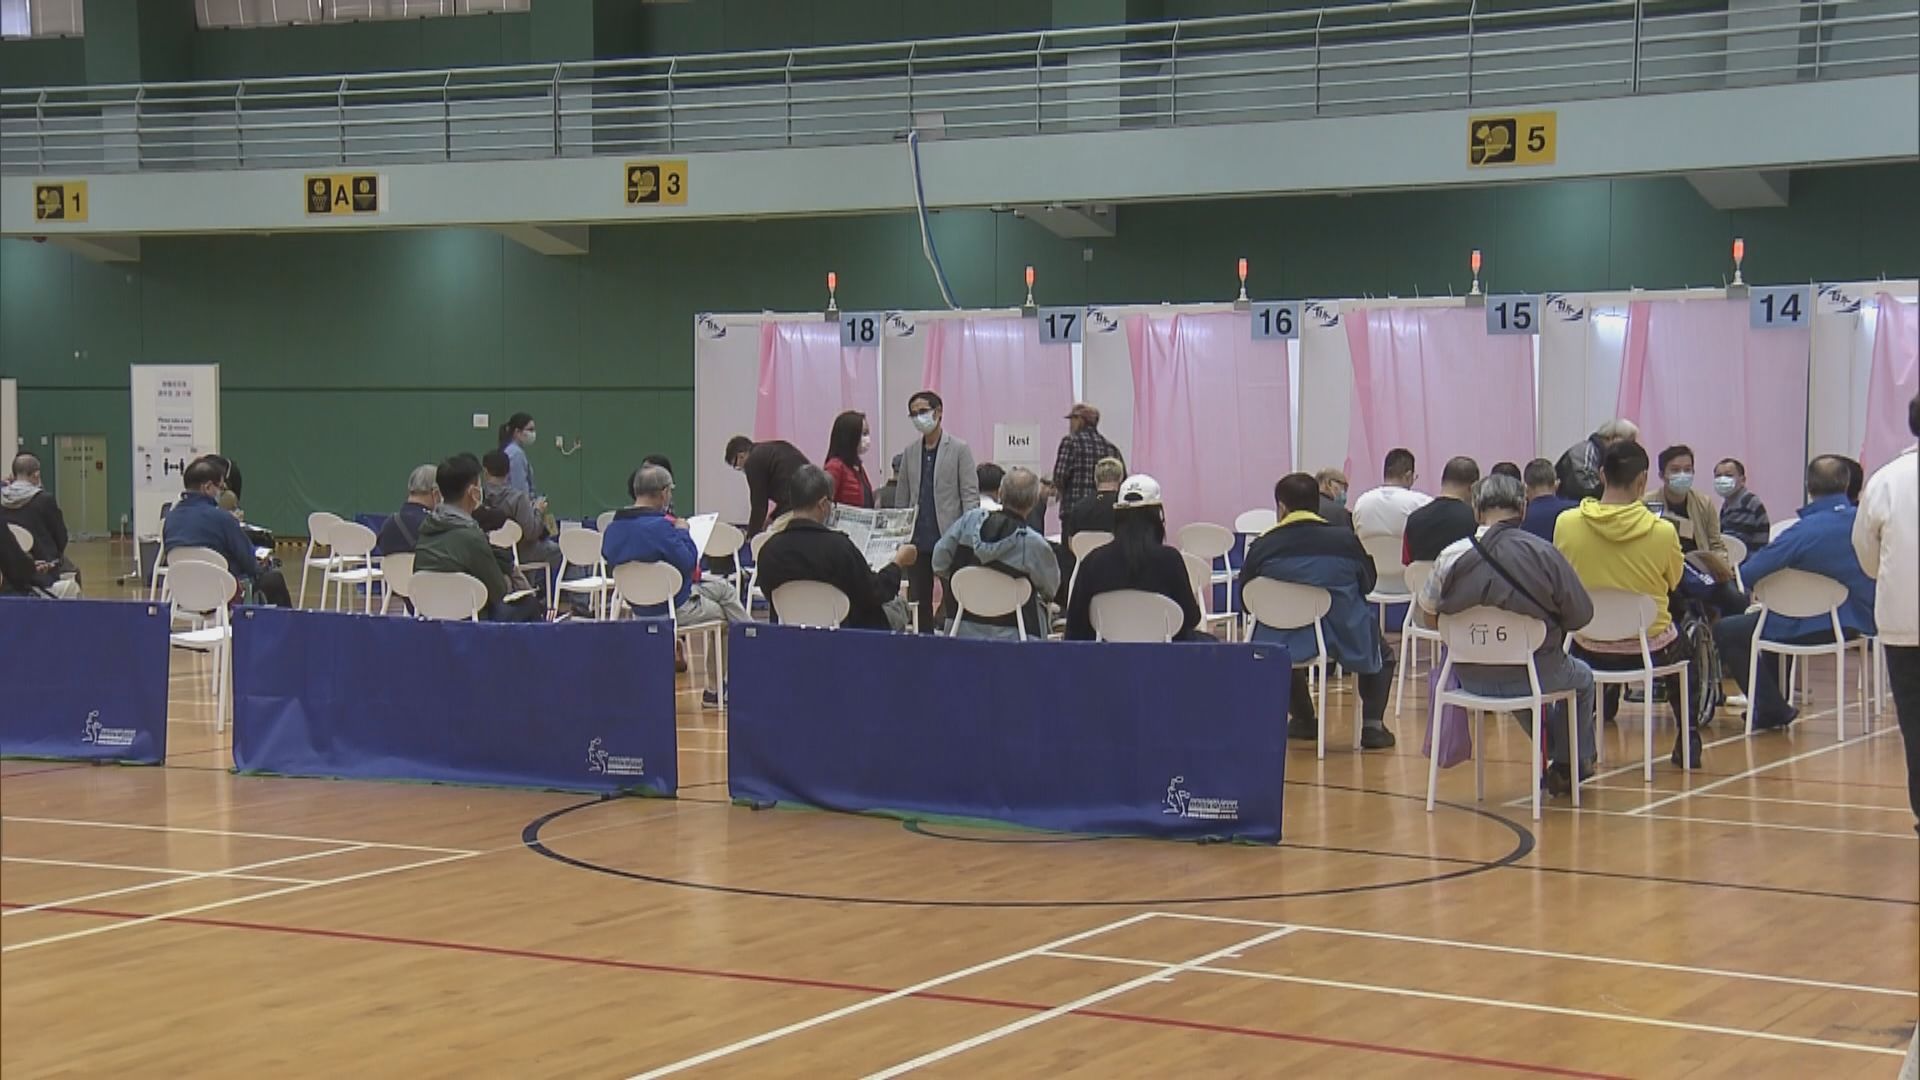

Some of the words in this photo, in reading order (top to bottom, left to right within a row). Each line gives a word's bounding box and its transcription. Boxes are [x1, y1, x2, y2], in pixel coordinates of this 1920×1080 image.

[1527, 125, 1546, 153] 5
[334, 184, 350, 206] A
[666, 172, 681, 196] 3
[72, 192, 80, 213] 1
[1494, 301, 1532, 330] 15
[1759, 293, 1802, 323] 14
[846, 317, 875, 343] 18
[1045, 313, 1077, 339] 17
[1259, 308, 1292, 335] 16
[1008, 434, 1030, 446] Rest
[1470, 622, 1488, 646] 行
[1496, 625, 1507, 642] 6
